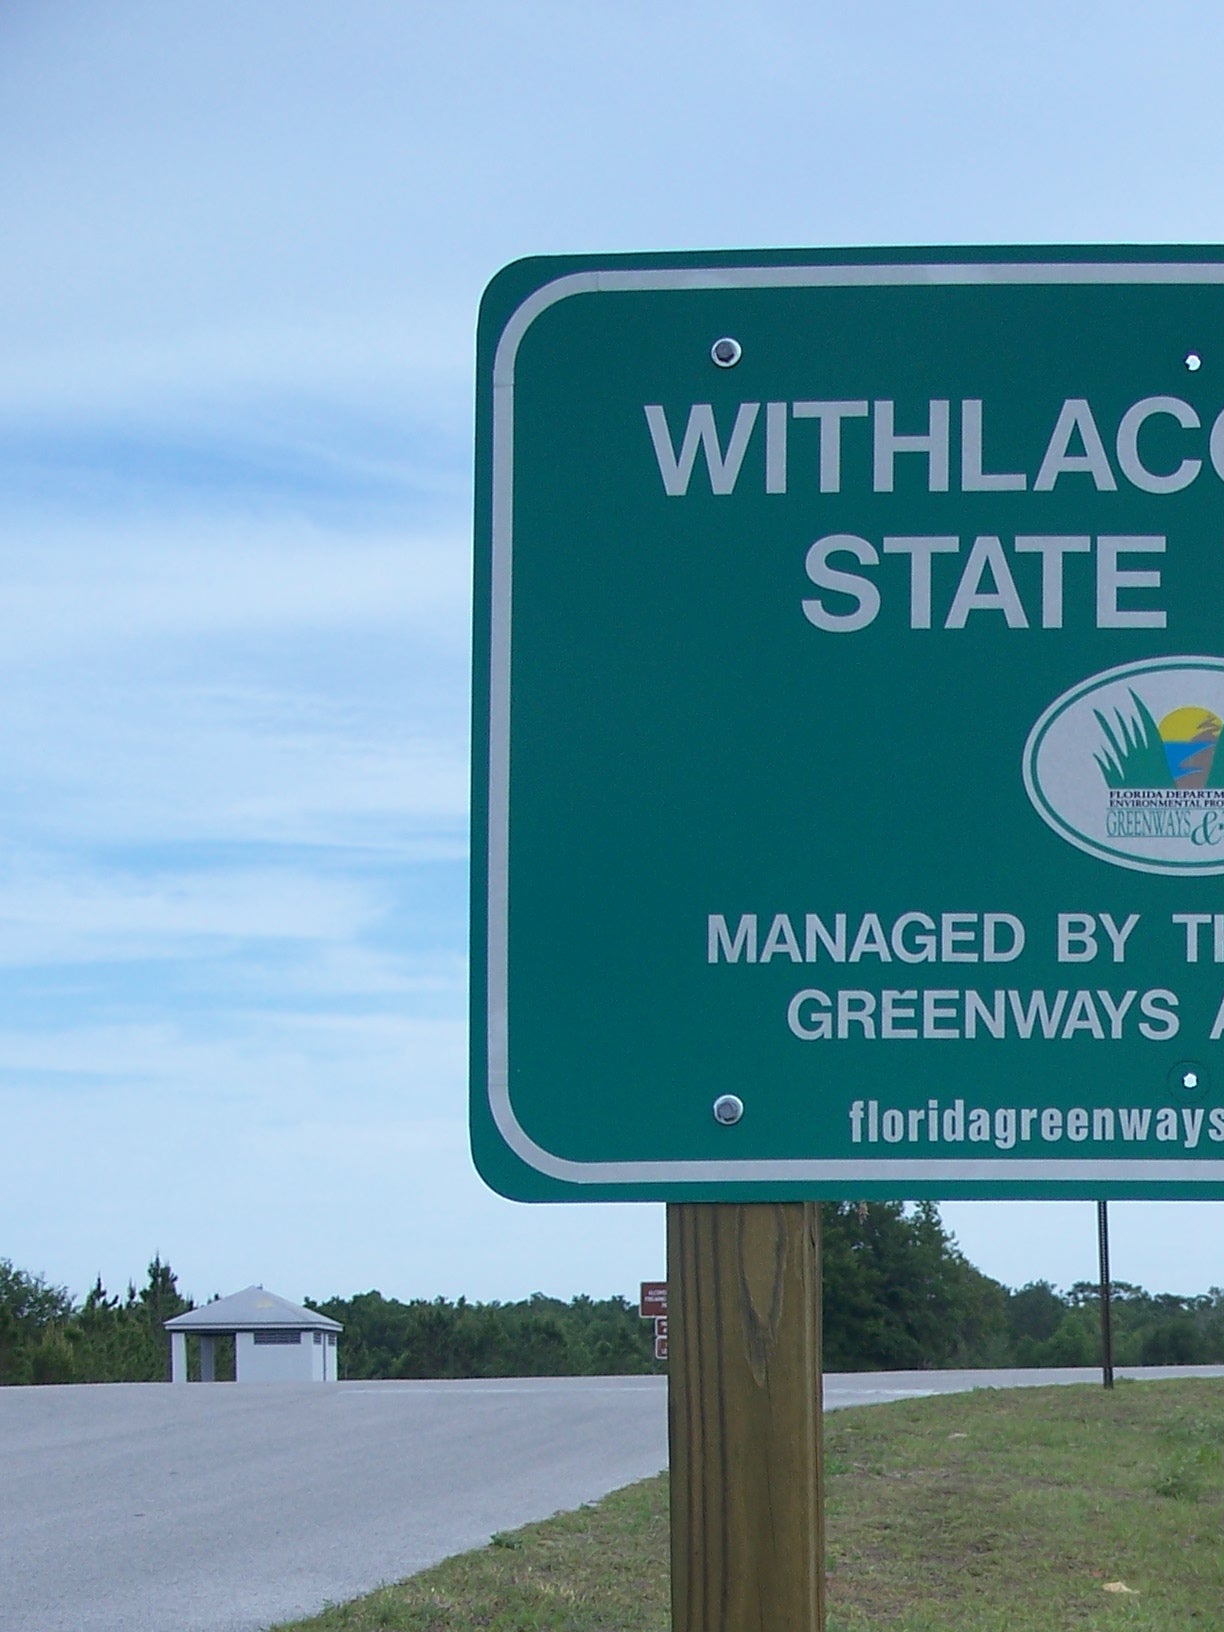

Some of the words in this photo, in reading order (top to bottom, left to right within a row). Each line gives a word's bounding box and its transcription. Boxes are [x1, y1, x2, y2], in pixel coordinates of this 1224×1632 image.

[803, 535, 1167, 632] STATE
[1109, 790, 1163, 799] FLORIDA
[1109, 800, 1202, 808] ENVIRONMENTAL
[1106, 809, 1191, 837] GREENWAYS
[1190, 810, 1224, 846] &
[709, 912, 1024, 963] MANAGED
[1059, 914, 1139, 962] BY
[787, 989, 1180, 1040] GREENWAYS
